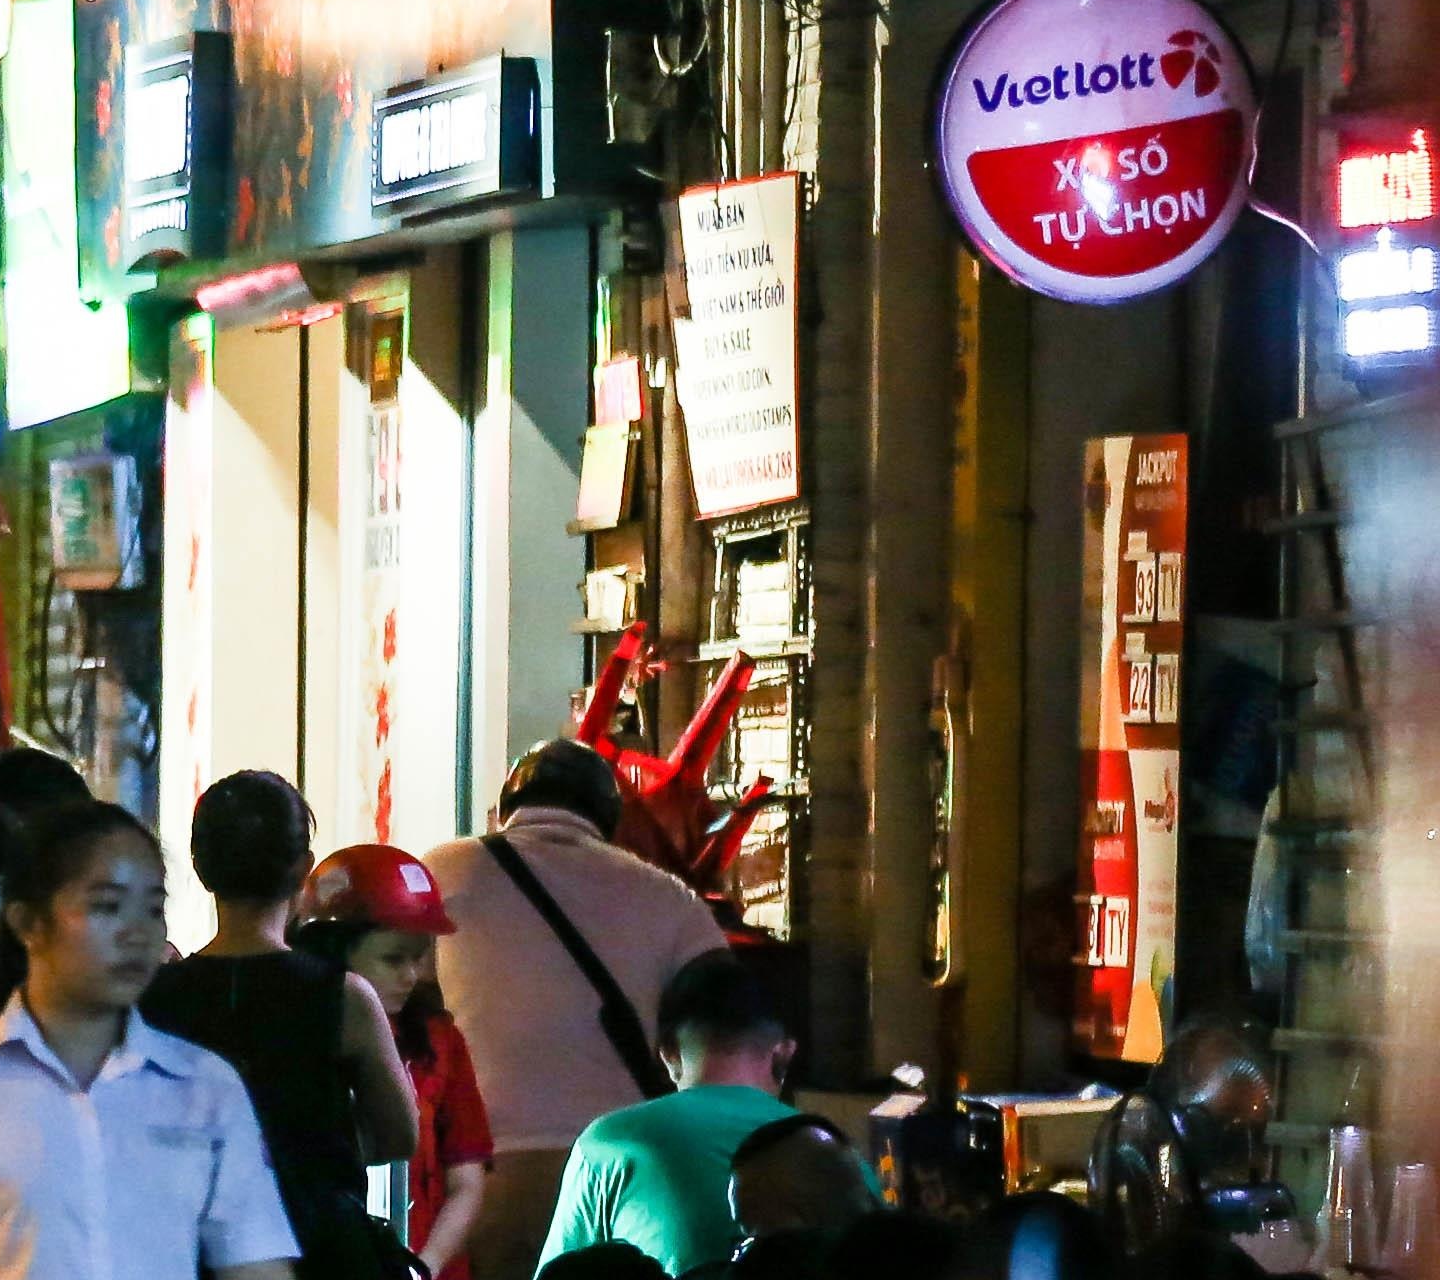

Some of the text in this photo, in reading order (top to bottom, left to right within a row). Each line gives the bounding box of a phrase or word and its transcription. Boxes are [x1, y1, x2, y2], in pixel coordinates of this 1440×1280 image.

[972, 51, 1155, 113] Vietlott
[1117, 132, 1169, 183] SỐ
[1032, 187, 1207, 250] TỰ CHỌN
[730, 327, 752, 354] SALE
[763, 403, 792, 431] STAMPS
[1135, 450, 1178, 486] JACKPOT
[1136, 567, 1154, 616] 93
[1130, 665, 1149, 711] 22
